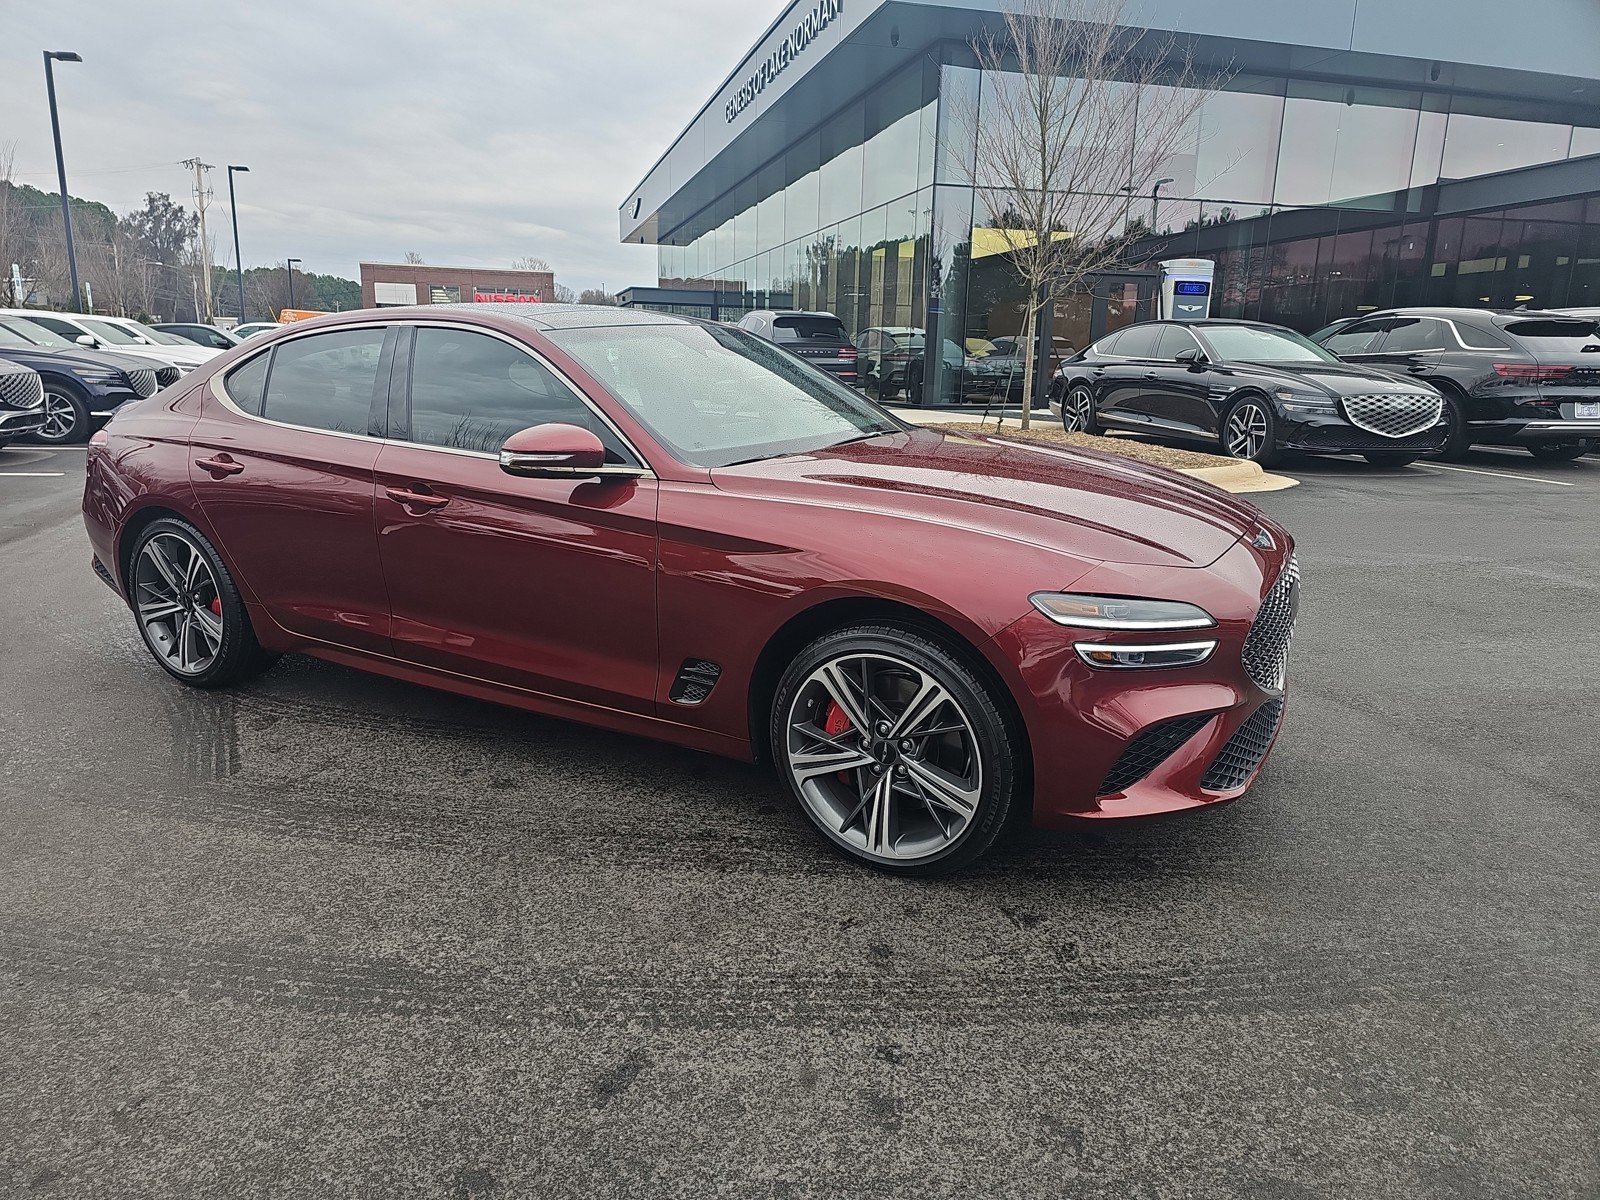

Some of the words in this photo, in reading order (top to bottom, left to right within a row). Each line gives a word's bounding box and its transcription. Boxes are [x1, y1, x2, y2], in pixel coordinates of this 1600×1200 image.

[724, 76, 755, 124] GENESIS
[754, 62, 767, 94] OF
[765, 39, 789, 84] LAKE
[788, 0, 843, 61] NORMAN
[475, 293, 541, 302] NISSAN
